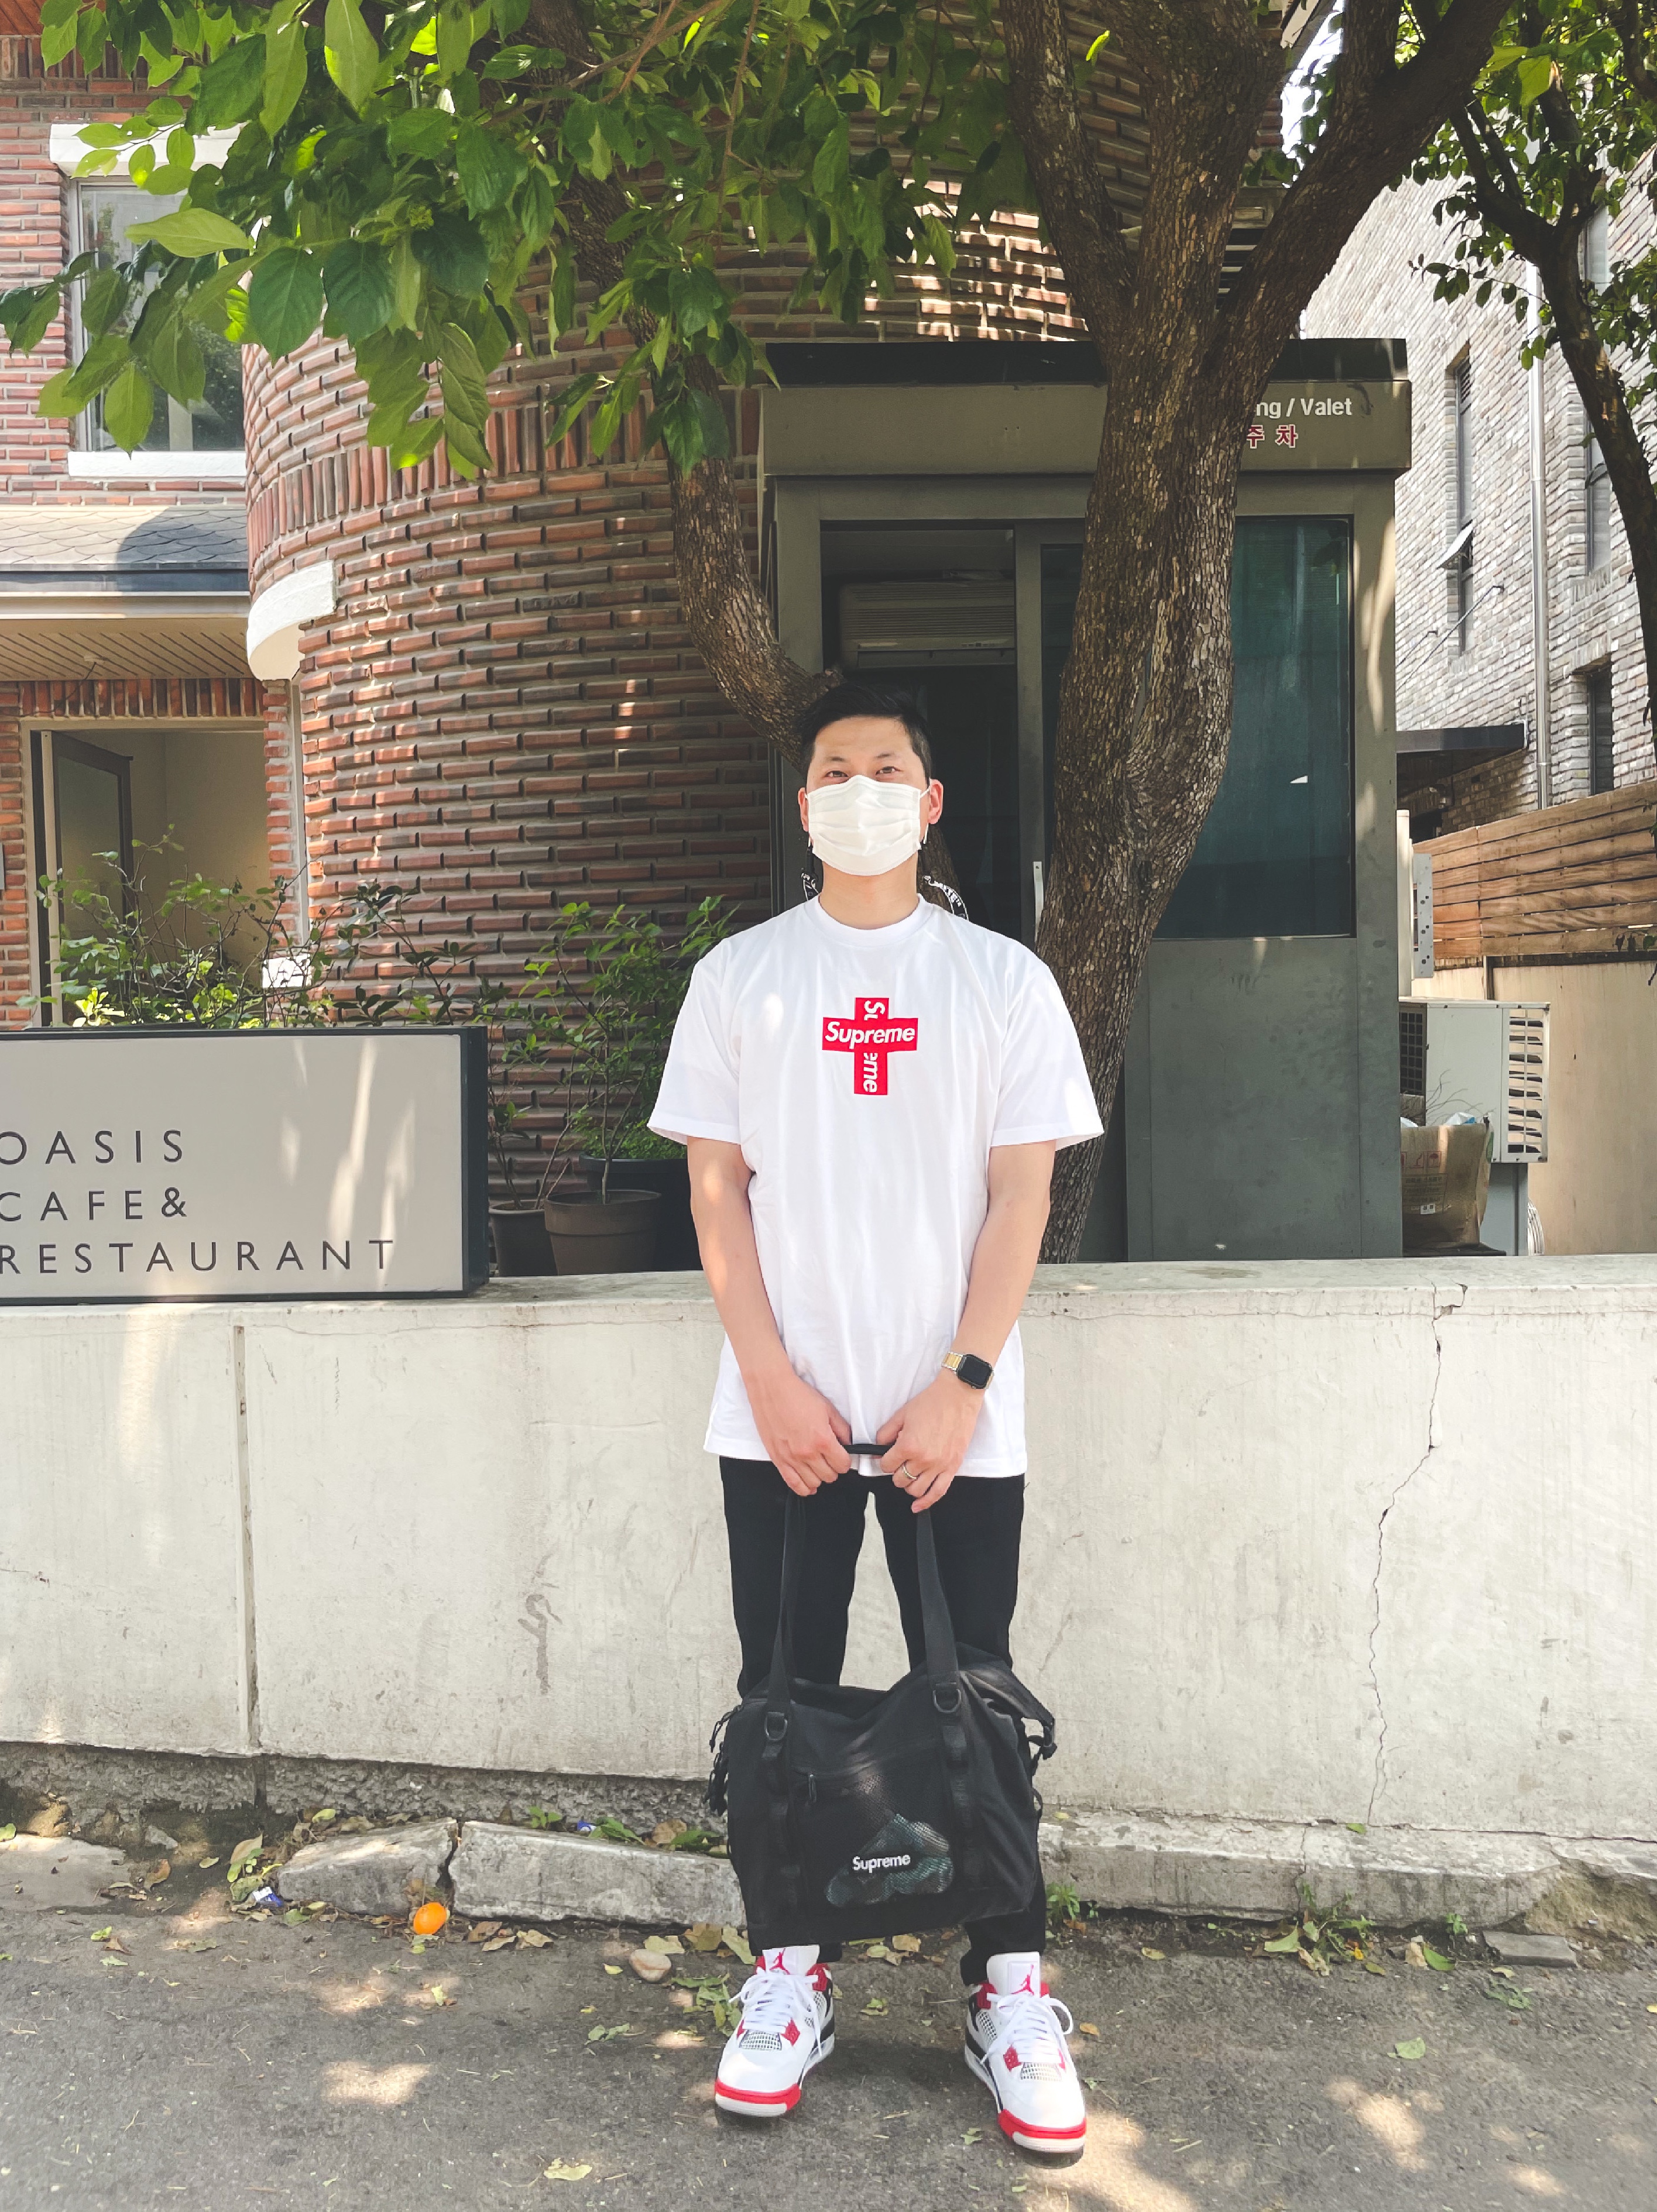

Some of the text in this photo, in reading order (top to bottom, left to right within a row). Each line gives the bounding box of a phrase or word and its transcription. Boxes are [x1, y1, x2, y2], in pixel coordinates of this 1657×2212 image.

[1300, 397, 1352, 416] Valet
[825, 1021, 915, 1050] Supreme
[0, 1129, 183, 1165] OASIS
[0, 1239, 394, 1275] RESTAURANT
[852, 1854, 911, 1873] Supreme
